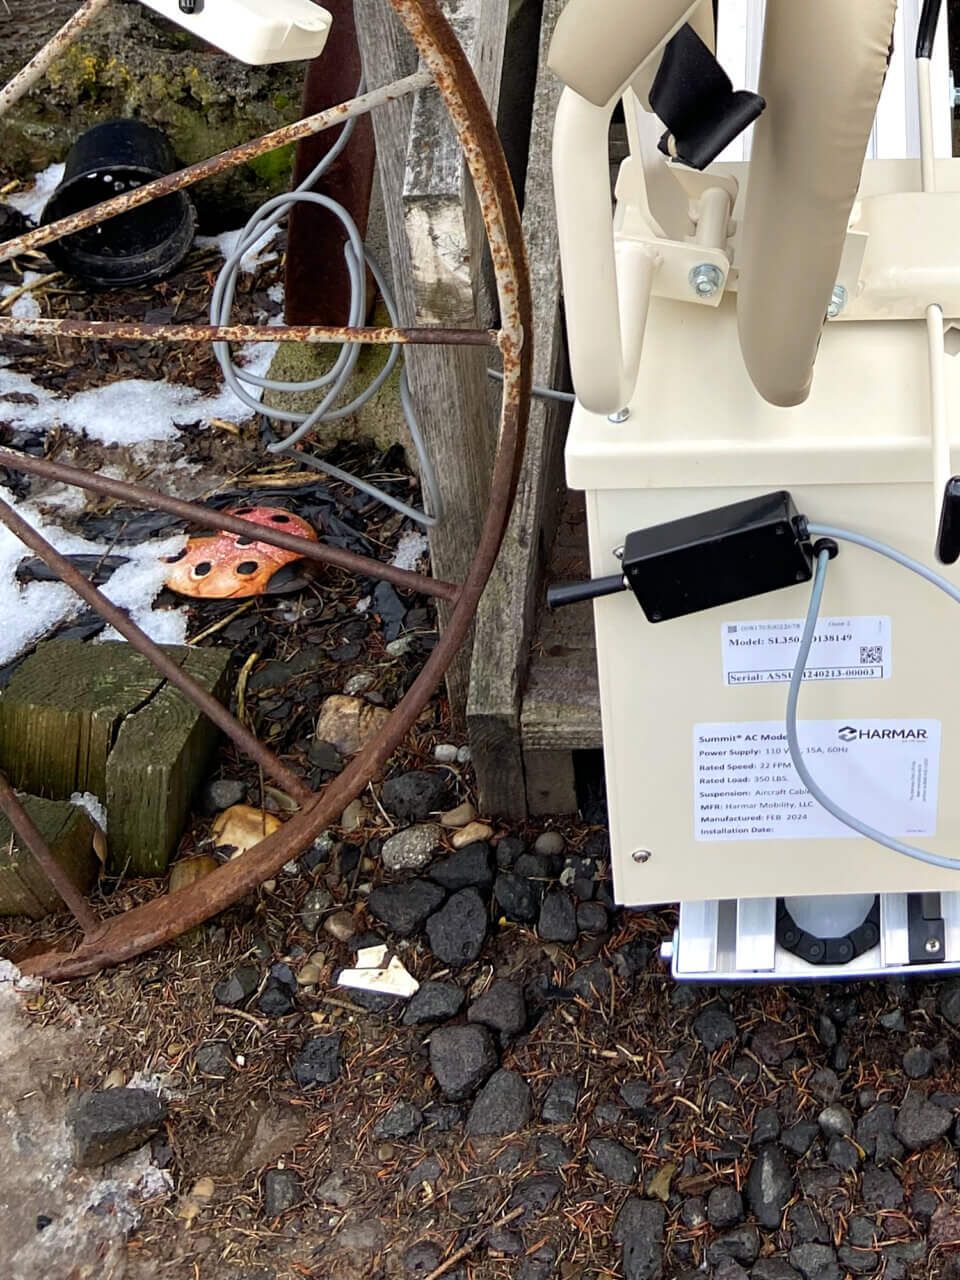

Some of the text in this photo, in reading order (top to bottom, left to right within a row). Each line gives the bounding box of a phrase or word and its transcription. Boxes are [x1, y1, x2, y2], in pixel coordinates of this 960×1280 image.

[728, 637, 765, 646] Model:
[730, 673, 764, 682] Serial:
[858, 728, 928, 739] HARMAR
[729, 748, 761, 756] Supply:
[806, 746, 824, 754] 15A,
[827, 745, 848, 753] 60Hz
[727, 763, 757, 771] Speed:
[699, 790, 751, 798] Suspension:
[700, 815, 763, 823] Manufactured:
[700, 827, 749, 835] Installation
